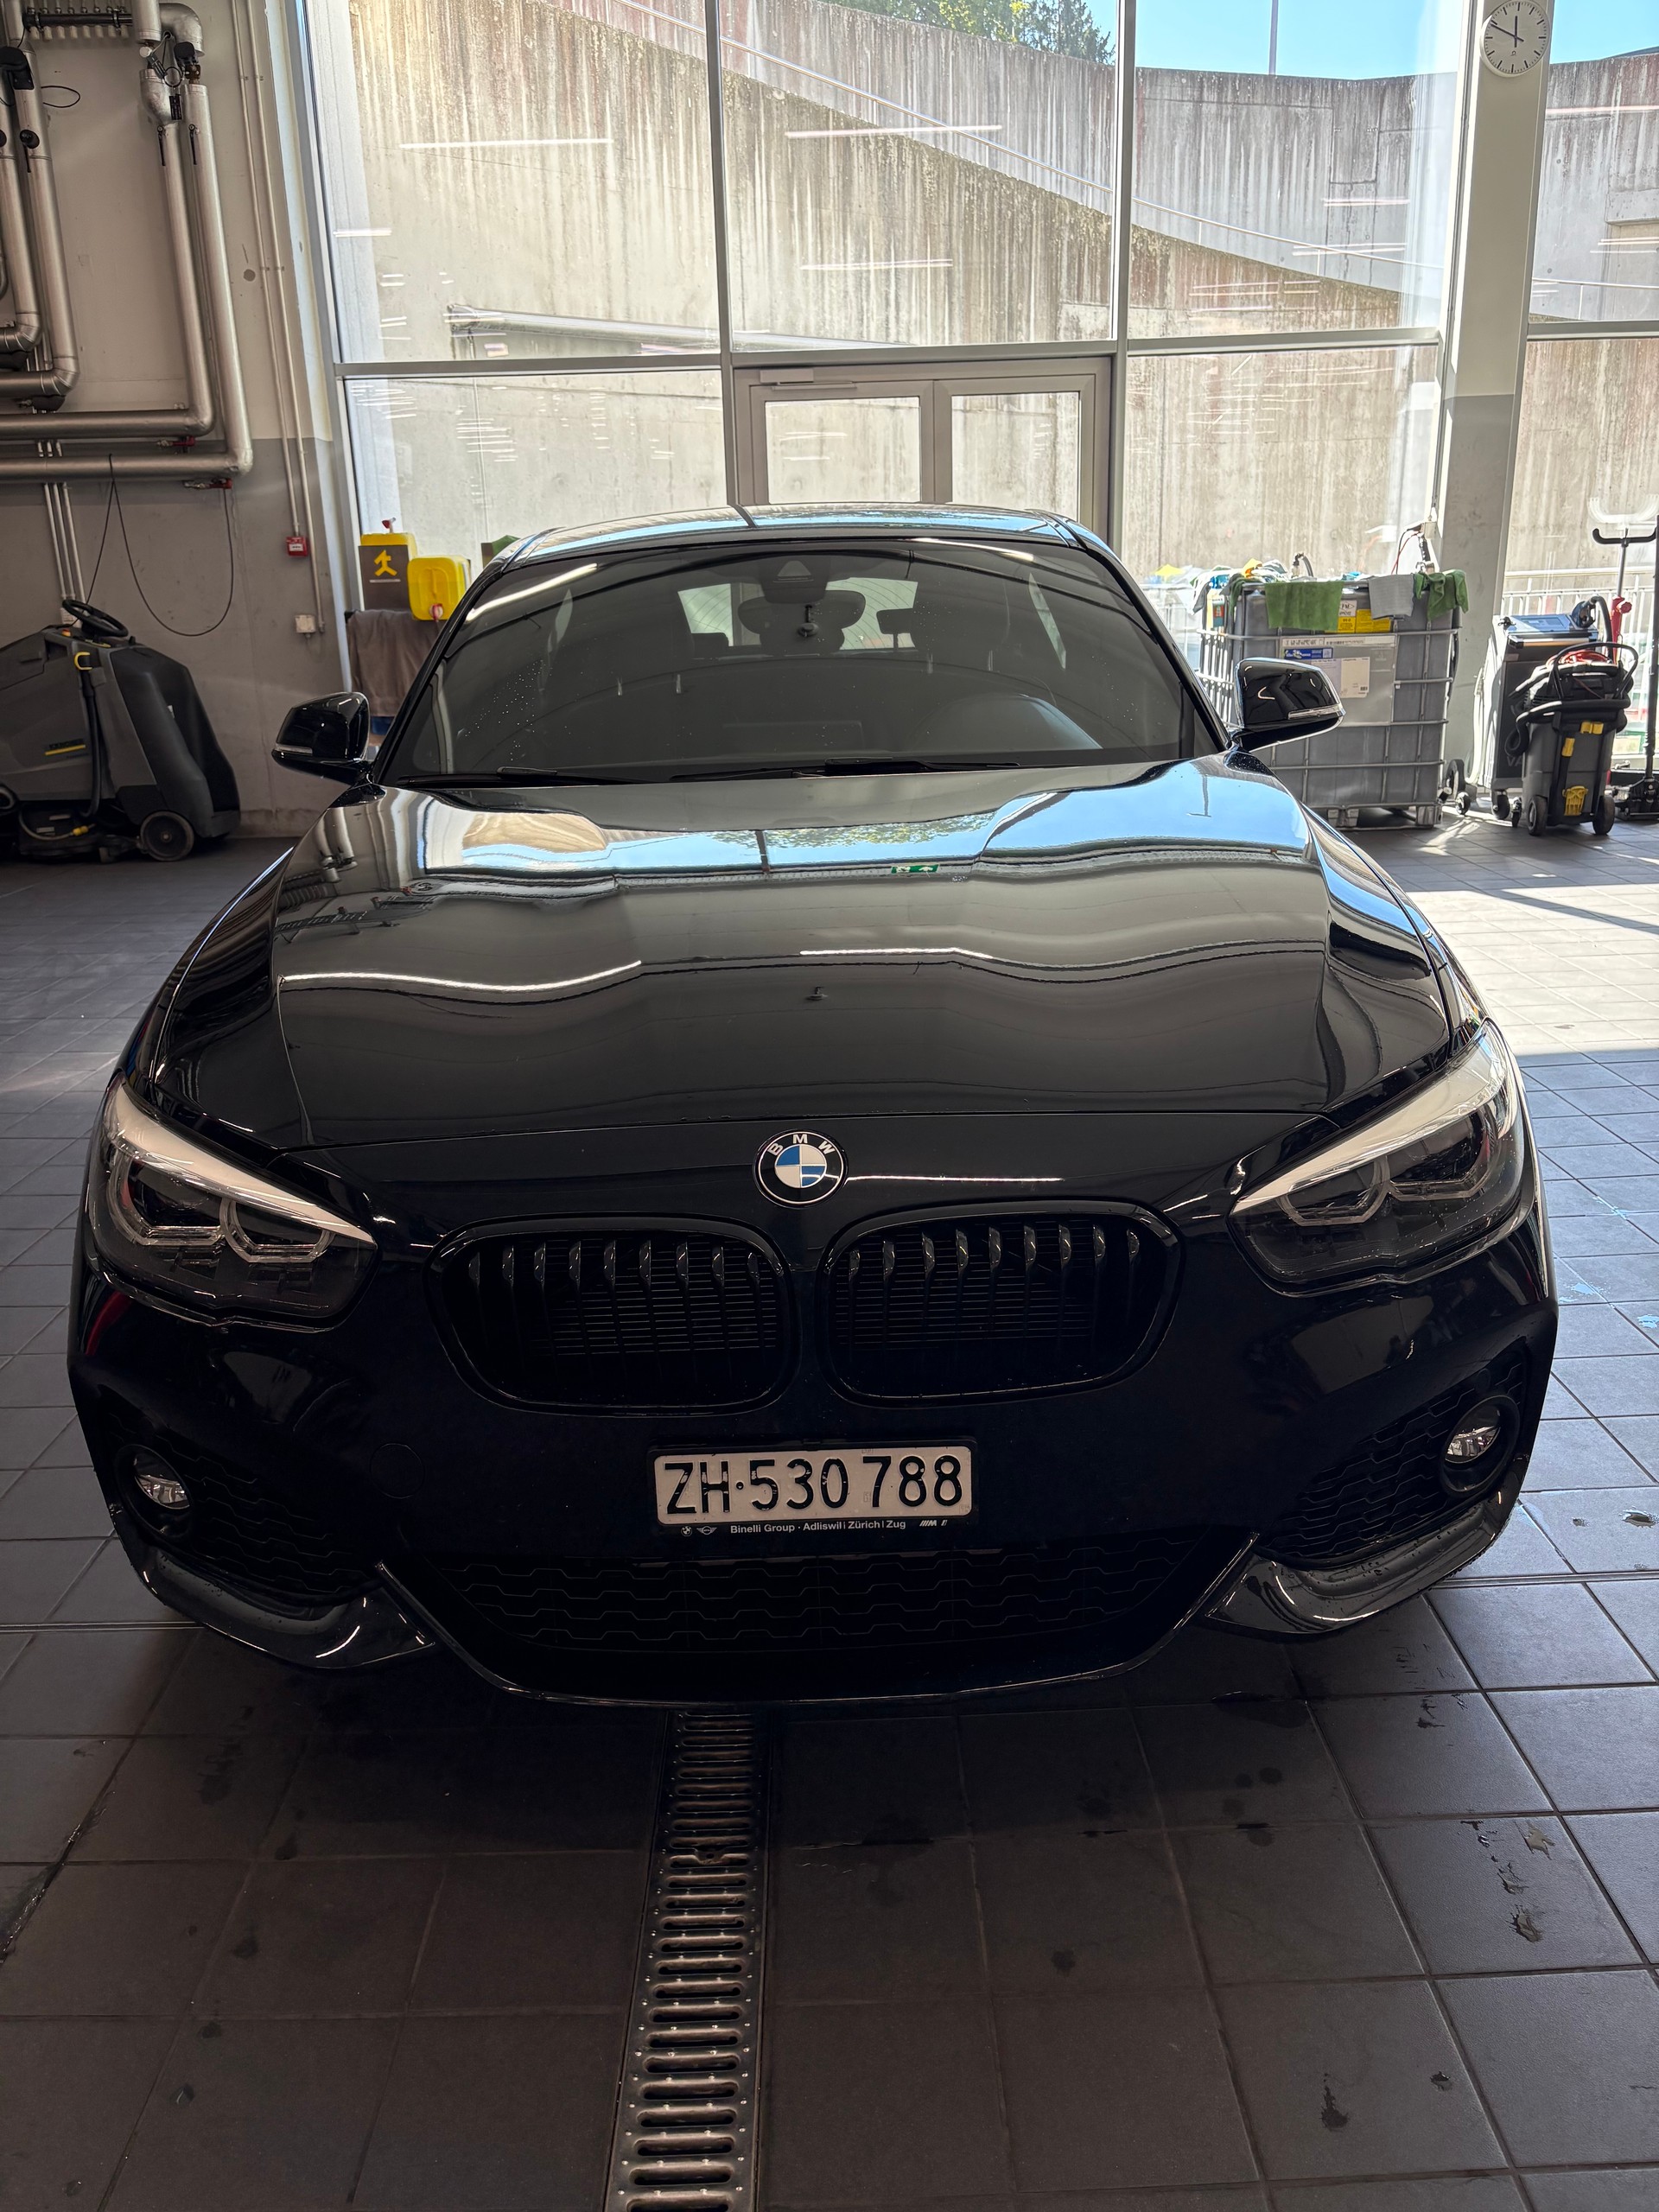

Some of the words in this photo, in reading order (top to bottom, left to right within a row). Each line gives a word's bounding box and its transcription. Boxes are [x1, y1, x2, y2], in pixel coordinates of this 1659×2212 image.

[767, 1134, 836, 1156] BMW
[862, 1454, 963, 1509] 788
[730, 1524, 761, 1534] Binelli
[764, 1523, 795, 1533] Group
[803, 1522, 842, 1531] Adliswil
[848, 1520, 881, 1529] Zürich
[886, 1520, 906, 1529] Zug
